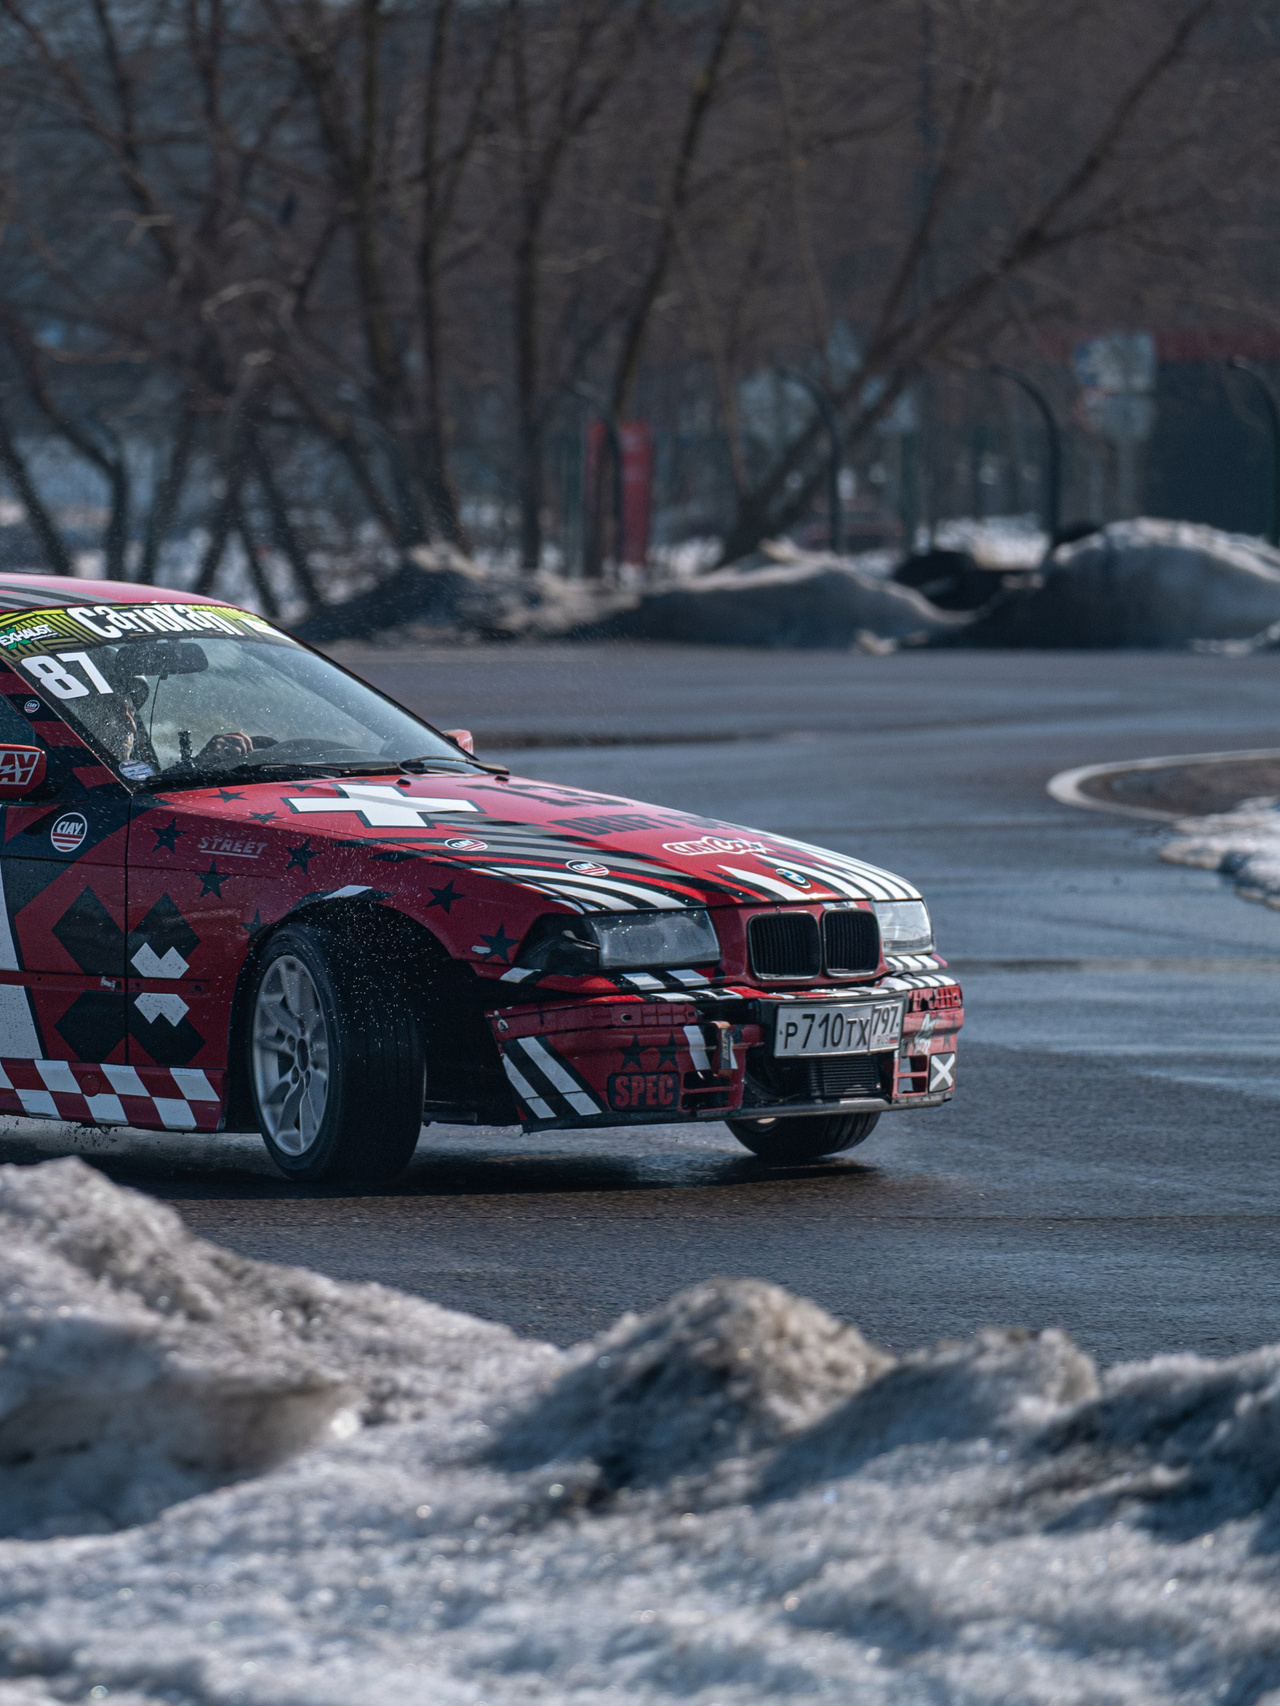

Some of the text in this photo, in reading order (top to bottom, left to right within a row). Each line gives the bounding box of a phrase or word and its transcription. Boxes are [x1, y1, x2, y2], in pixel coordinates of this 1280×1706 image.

[20, 651, 114, 700] 87
[197, 836, 269, 855] STREET
[872, 1006, 900, 1036] 797
[614, 1074, 674, 1107] SPEC
